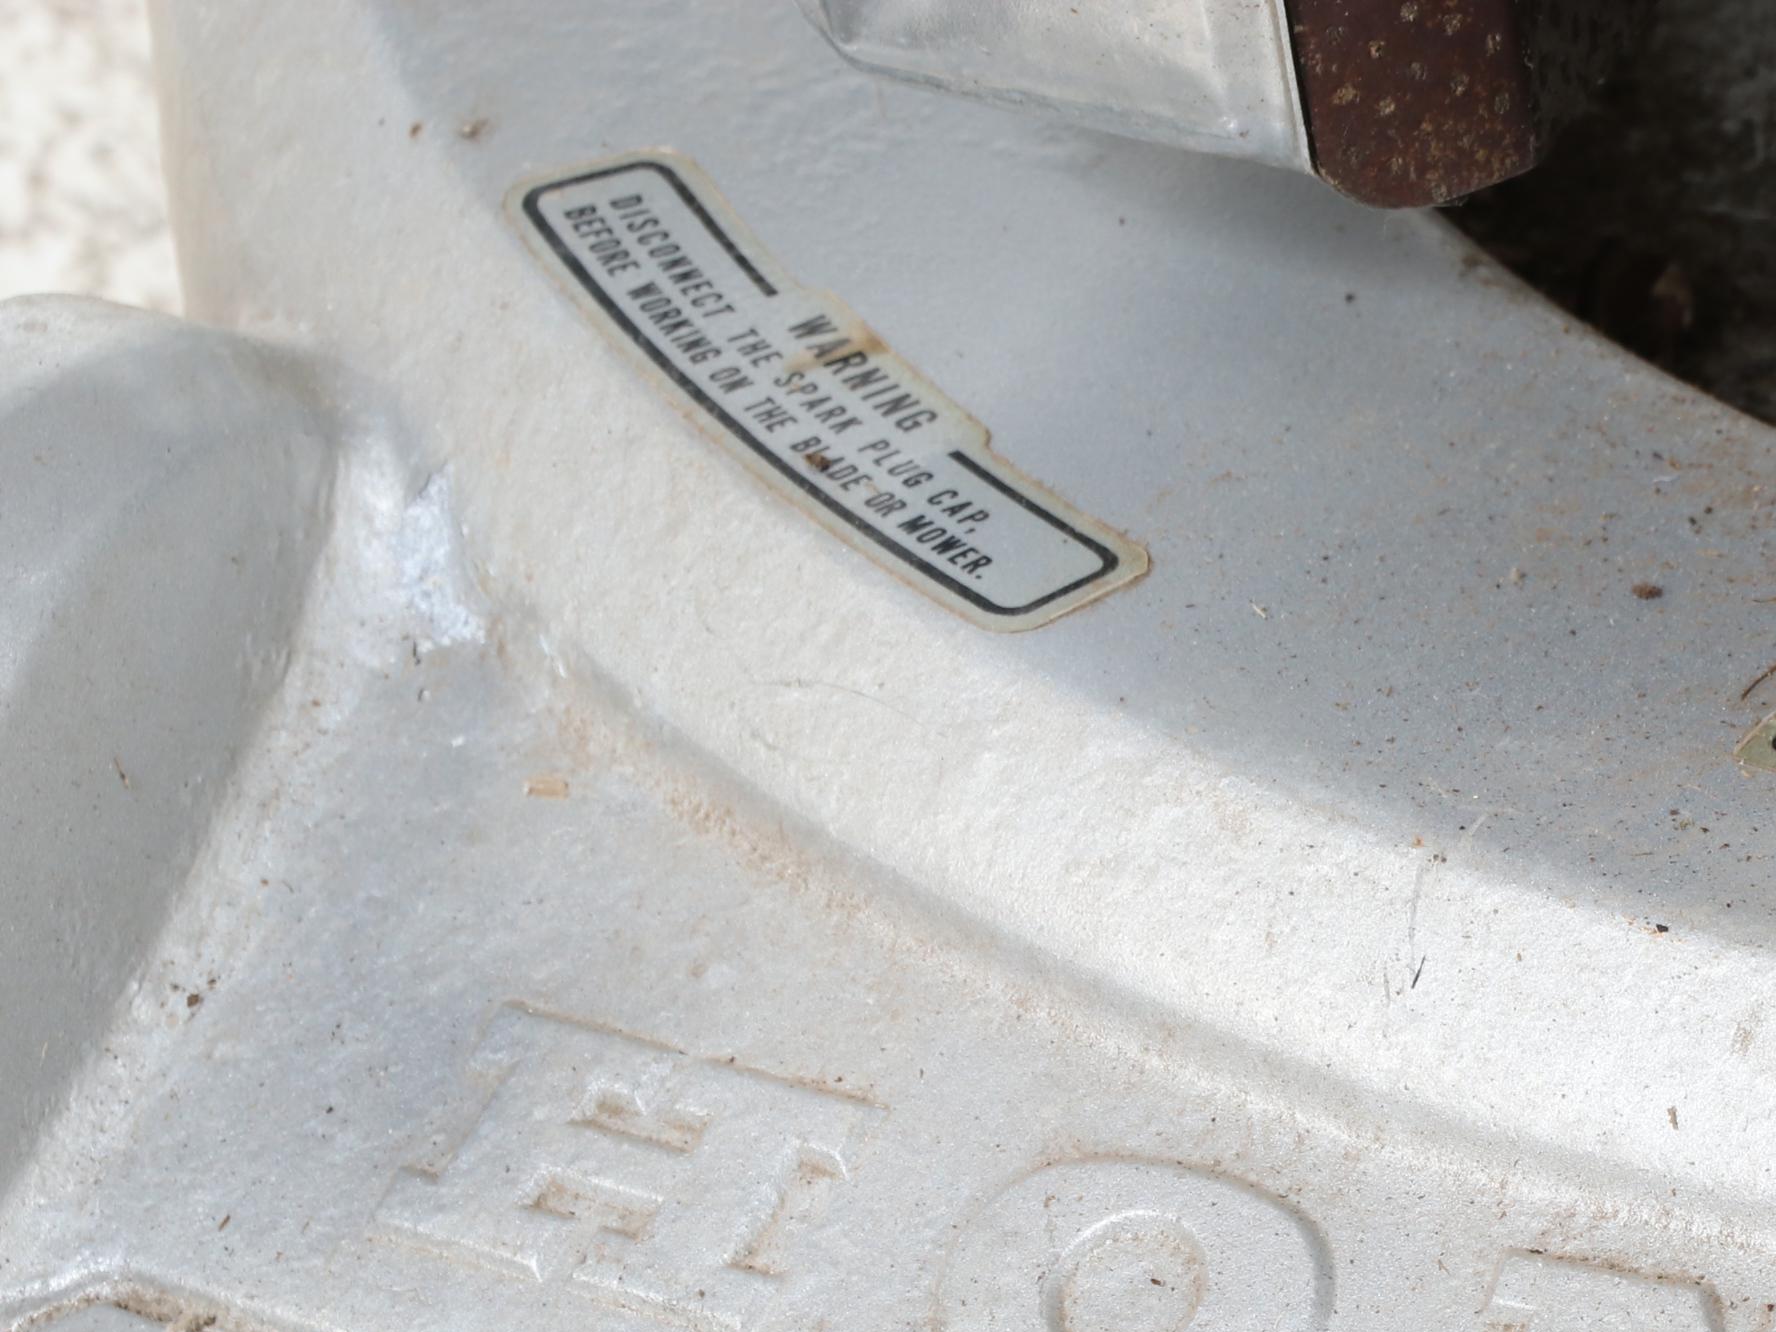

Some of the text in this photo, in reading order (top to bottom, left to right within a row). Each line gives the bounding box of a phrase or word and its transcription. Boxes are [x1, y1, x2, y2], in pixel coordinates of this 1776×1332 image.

[564, 205, 641, 277] BEFORE
[627, 281, 722, 365] WORKING
[709, 366, 755, 394] ON
[744, 396, 798, 433] THE
[864, 491, 907, 518] OR
[898, 514, 993, 580] MOWER.
[609, 194, 736, 319] DISCONNECT
[727, 328, 784, 368] THE
[773, 371, 863, 435] SPARK
[857, 439, 934, 488] PLUG
[788, 314, 938, 433] WARNING
